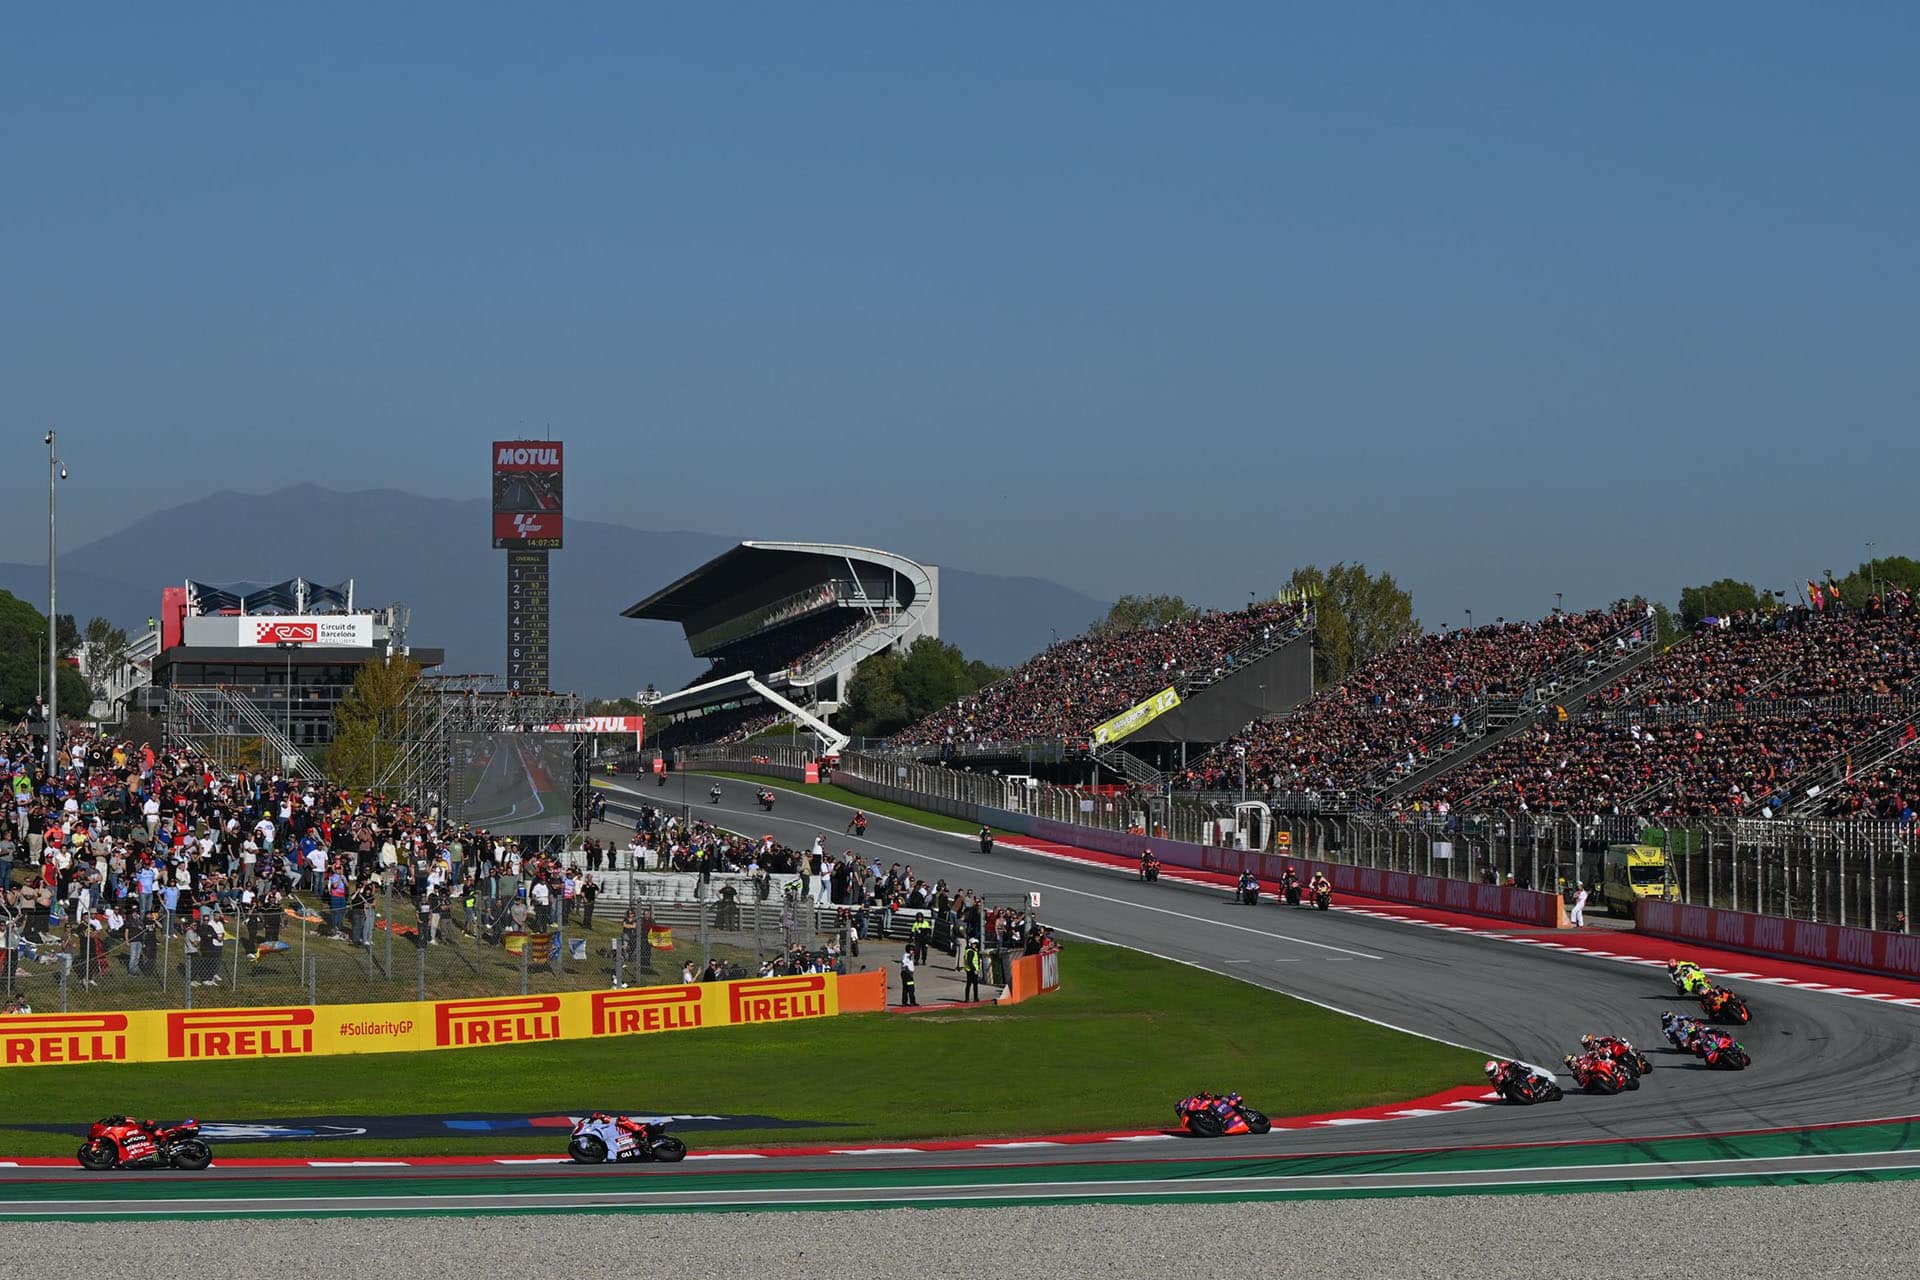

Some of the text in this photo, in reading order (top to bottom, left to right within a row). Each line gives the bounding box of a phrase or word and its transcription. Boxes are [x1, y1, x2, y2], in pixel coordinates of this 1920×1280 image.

[497, 448, 560, 465] MOTUL
[527, 539, 560, 547] 14:07:32
[513, 568, 519, 578] 1
[513, 584, 520, 594] 2
[513, 600, 520, 610] 3
[513, 616, 520, 626] 4
[513, 632, 520, 641] 5
[513, 648, 520, 658] 6
[513, 664, 520, 674] 7
[513, 680, 520, 690] 8
[1794, 922, 1827, 959] MOTUL
[1837, 928, 1873, 965] MOTUL
[1884, 935, 1920, 972] MOTU
[729, 976, 826, 1023] PIRELLI
[592, 986, 702, 1034] PIRELLI
[339, 1020, 413, 1037] #SolidarityGP
[436, 997, 561, 1047] PIRELLI
[167, 1008, 315, 1058] PIRELLI
